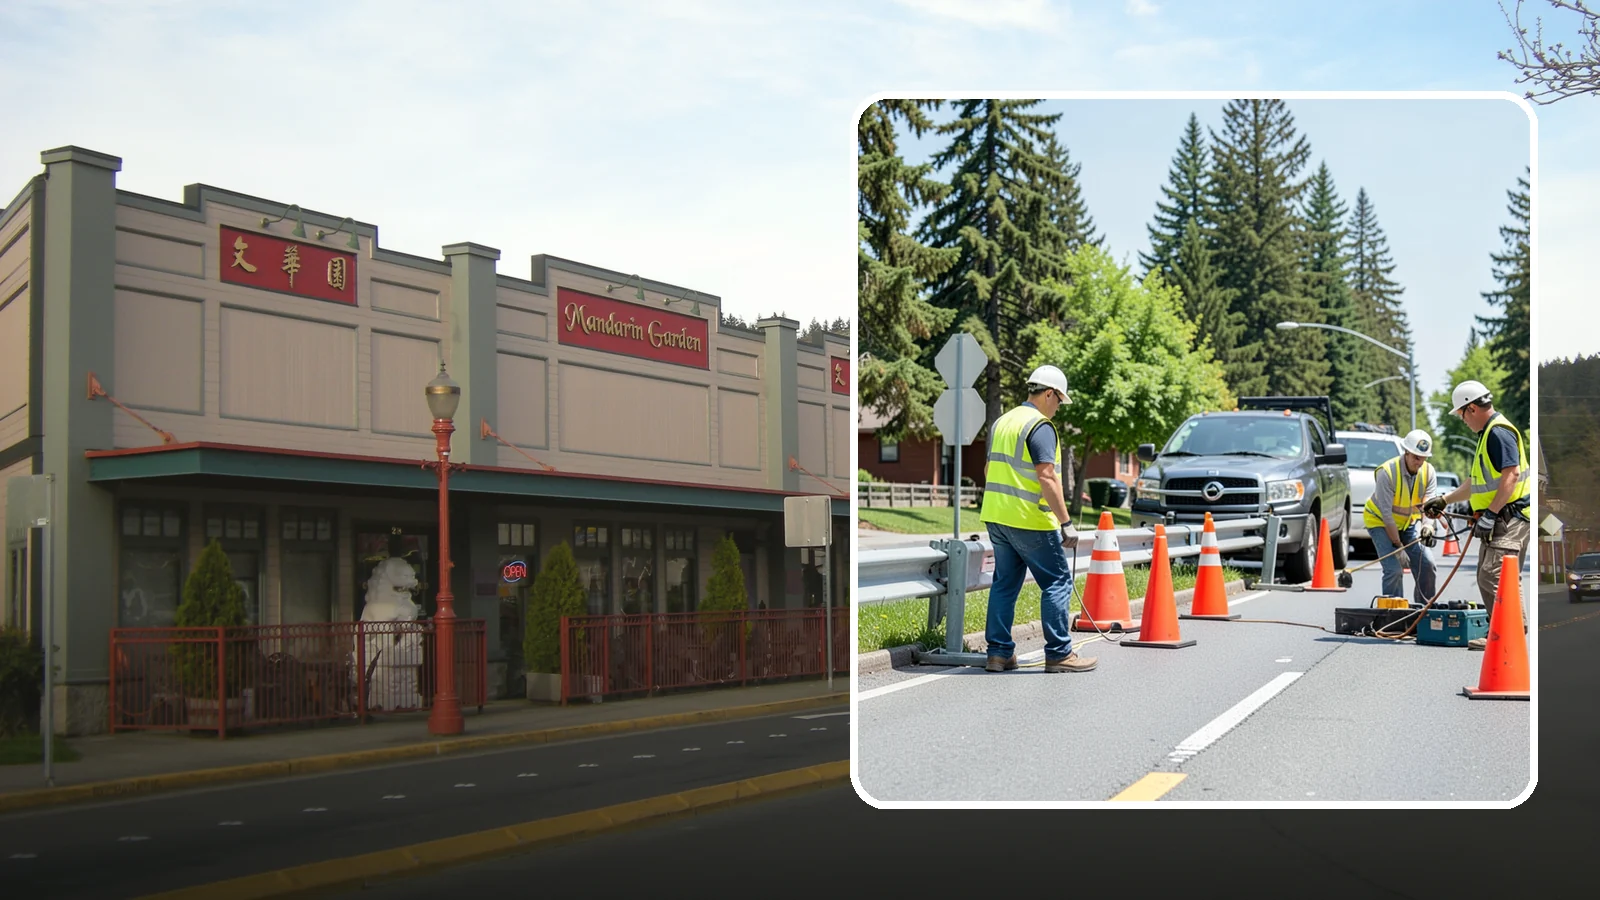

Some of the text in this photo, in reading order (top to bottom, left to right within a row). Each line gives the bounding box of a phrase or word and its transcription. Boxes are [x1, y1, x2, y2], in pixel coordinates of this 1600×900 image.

[564, 302, 702, 352] Mandarin Garden
[504, 565, 527, 578] OPEN
